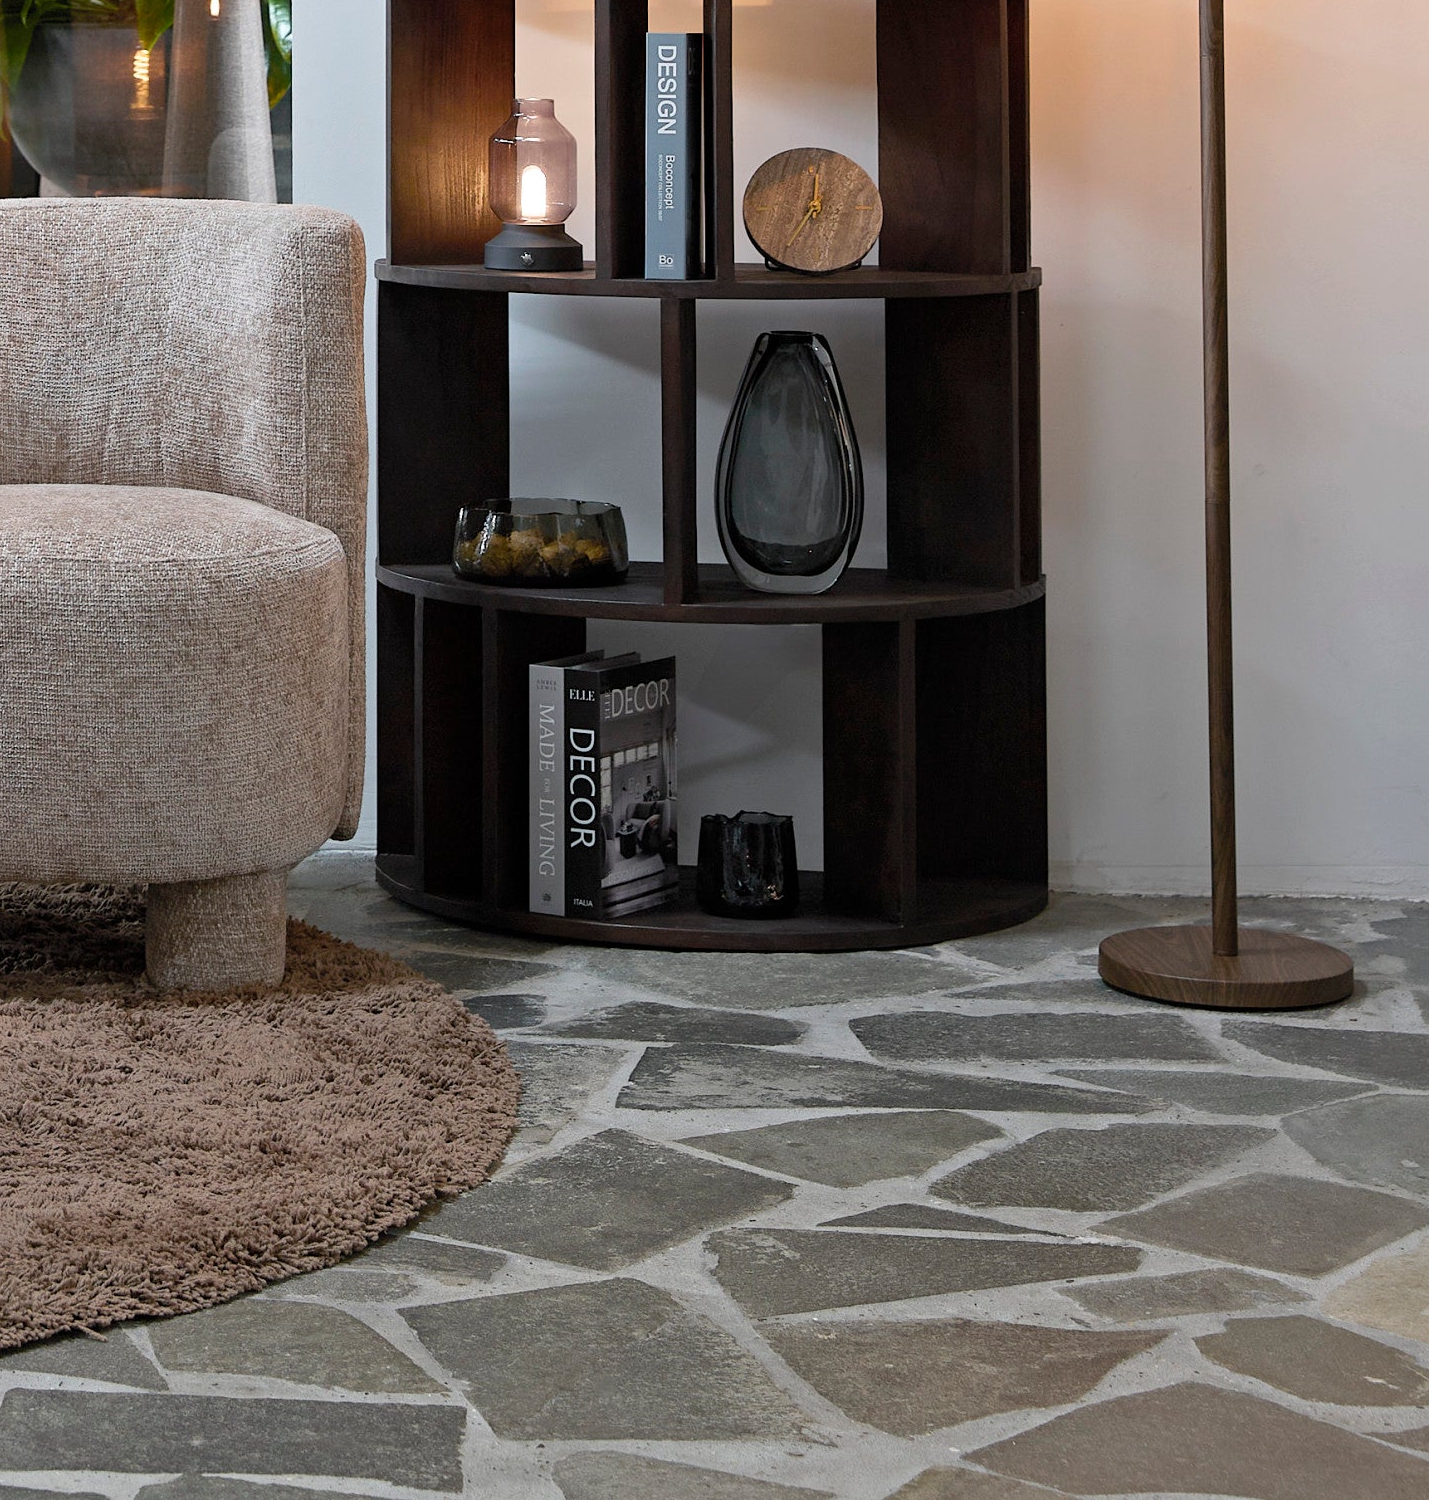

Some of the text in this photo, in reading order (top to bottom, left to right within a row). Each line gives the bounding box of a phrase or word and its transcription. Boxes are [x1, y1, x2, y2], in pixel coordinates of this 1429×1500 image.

[657, 45, 677, 135] DESIGN
[663, 154, 676, 209] Boconcept
[659, 254, 674, 265] Bo
[569, 688, 596, 702] ELLE
[611, 678, 670, 718] DECOR
[539, 705, 555, 772] MADE
[569, 728, 596, 848] DECOR
[539, 799, 556, 877] LIVING
[573, 898, 593, 908] ITALIA
